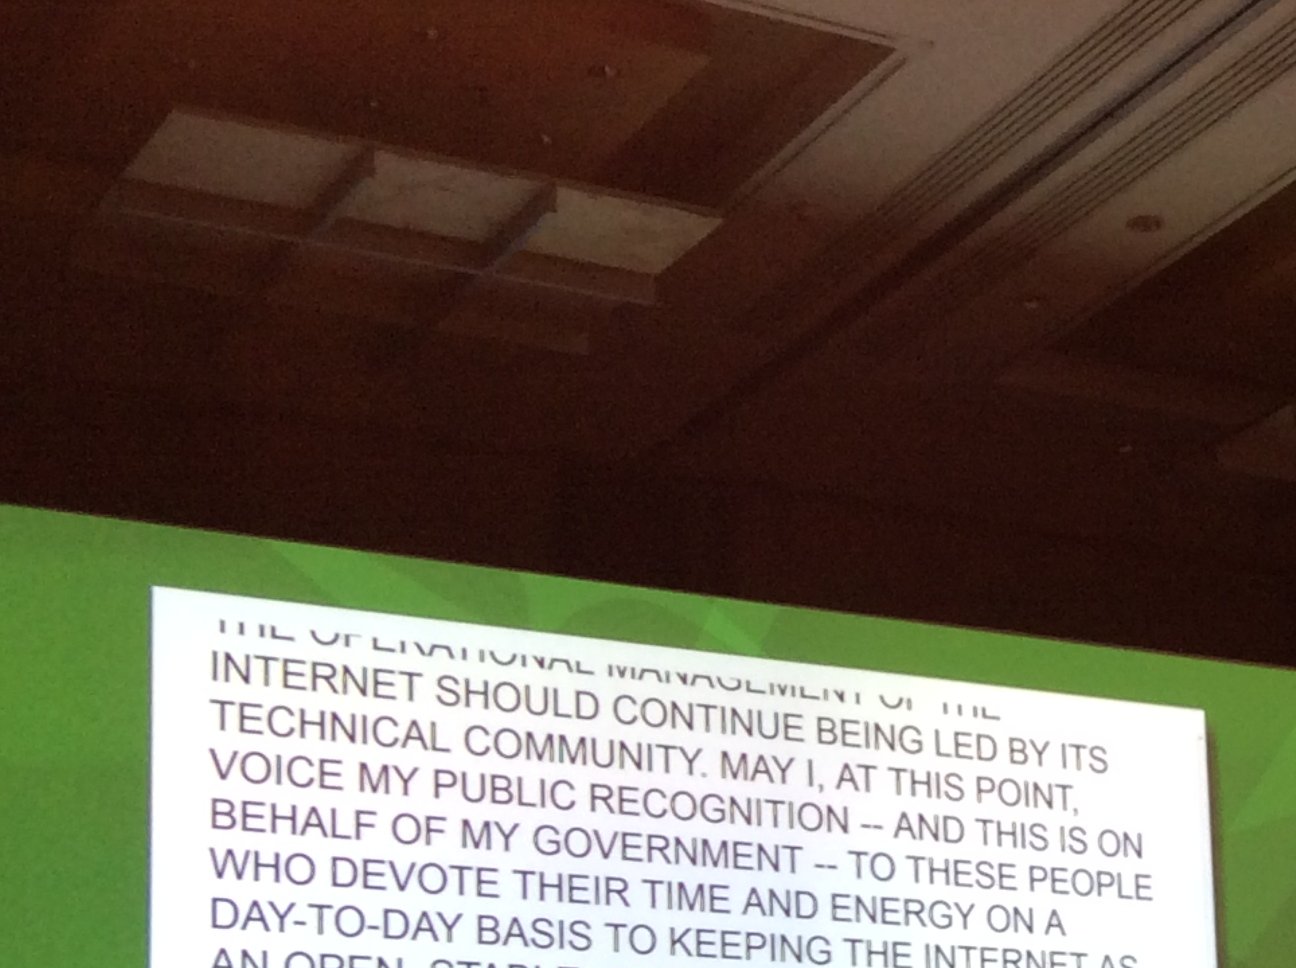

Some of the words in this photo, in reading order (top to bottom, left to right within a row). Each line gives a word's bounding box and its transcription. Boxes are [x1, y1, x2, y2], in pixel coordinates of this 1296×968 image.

[209, 699, 451, 753] TECHNICAL
[464, 724, 706, 777] COMMUNITY.
[721, 750, 795, 784] MAY
[807, 758, 823, 792] I,
[835, 762, 877, 792] AT
[887, 766, 964, 801] THIS
[976, 776, 1077, 814] POINT,
[212, 650, 423, 701] INTERNET
[436, 674, 599, 720] SHOULD
[613, 694, 804, 742] CONTINUE
[816, 716, 923, 754] BEING
[934, 729, 997, 761] LED
[1009, 737, 1049, 766] BY
[1061, 743, 1107, 773] ITS
[209, 748, 343, 790] VOICE
[359, 761, 419, 796] MY
[434, 768, 575, 811] PUBLIC
[590, 783, 848, 834] RECOGNITION
[893, 811, 964, 843] AND
[975, 818, 1048, 851] THIS
[1060, 826, 1087, 854] IS
[1098, 829, 1142, 859] ON
[211, 797, 377, 840] BEHALF
[391, 813, 447, 846] OF
[461, 818, 520, 851] MY
[533, 824, 803, 874] GOVERNMENT
[847, 850, 895, 882] TO
[905, 855, 1017, 890] THESE
[1028, 865, 1152, 901] PEOPLE
[209, 847, 315, 886] WHO
[331, 856, 500, 898] DEVOTE
[512, 869, 630, 907] THEIR
[641, 879, 731, 914] TIME
[741, 887, 818, 919] AND
[831, 892, 974, 929] ENERGY
[986, 904, 1033, 934] ON
[1045, 909, 1066, 936] A
[211, 897, 463, 942] DAY-TO-DAY
[477, 914, 592, 951] BASIS
[604, 922, 657, 955] TO
[669, 926, 831, 965] KEEPING
